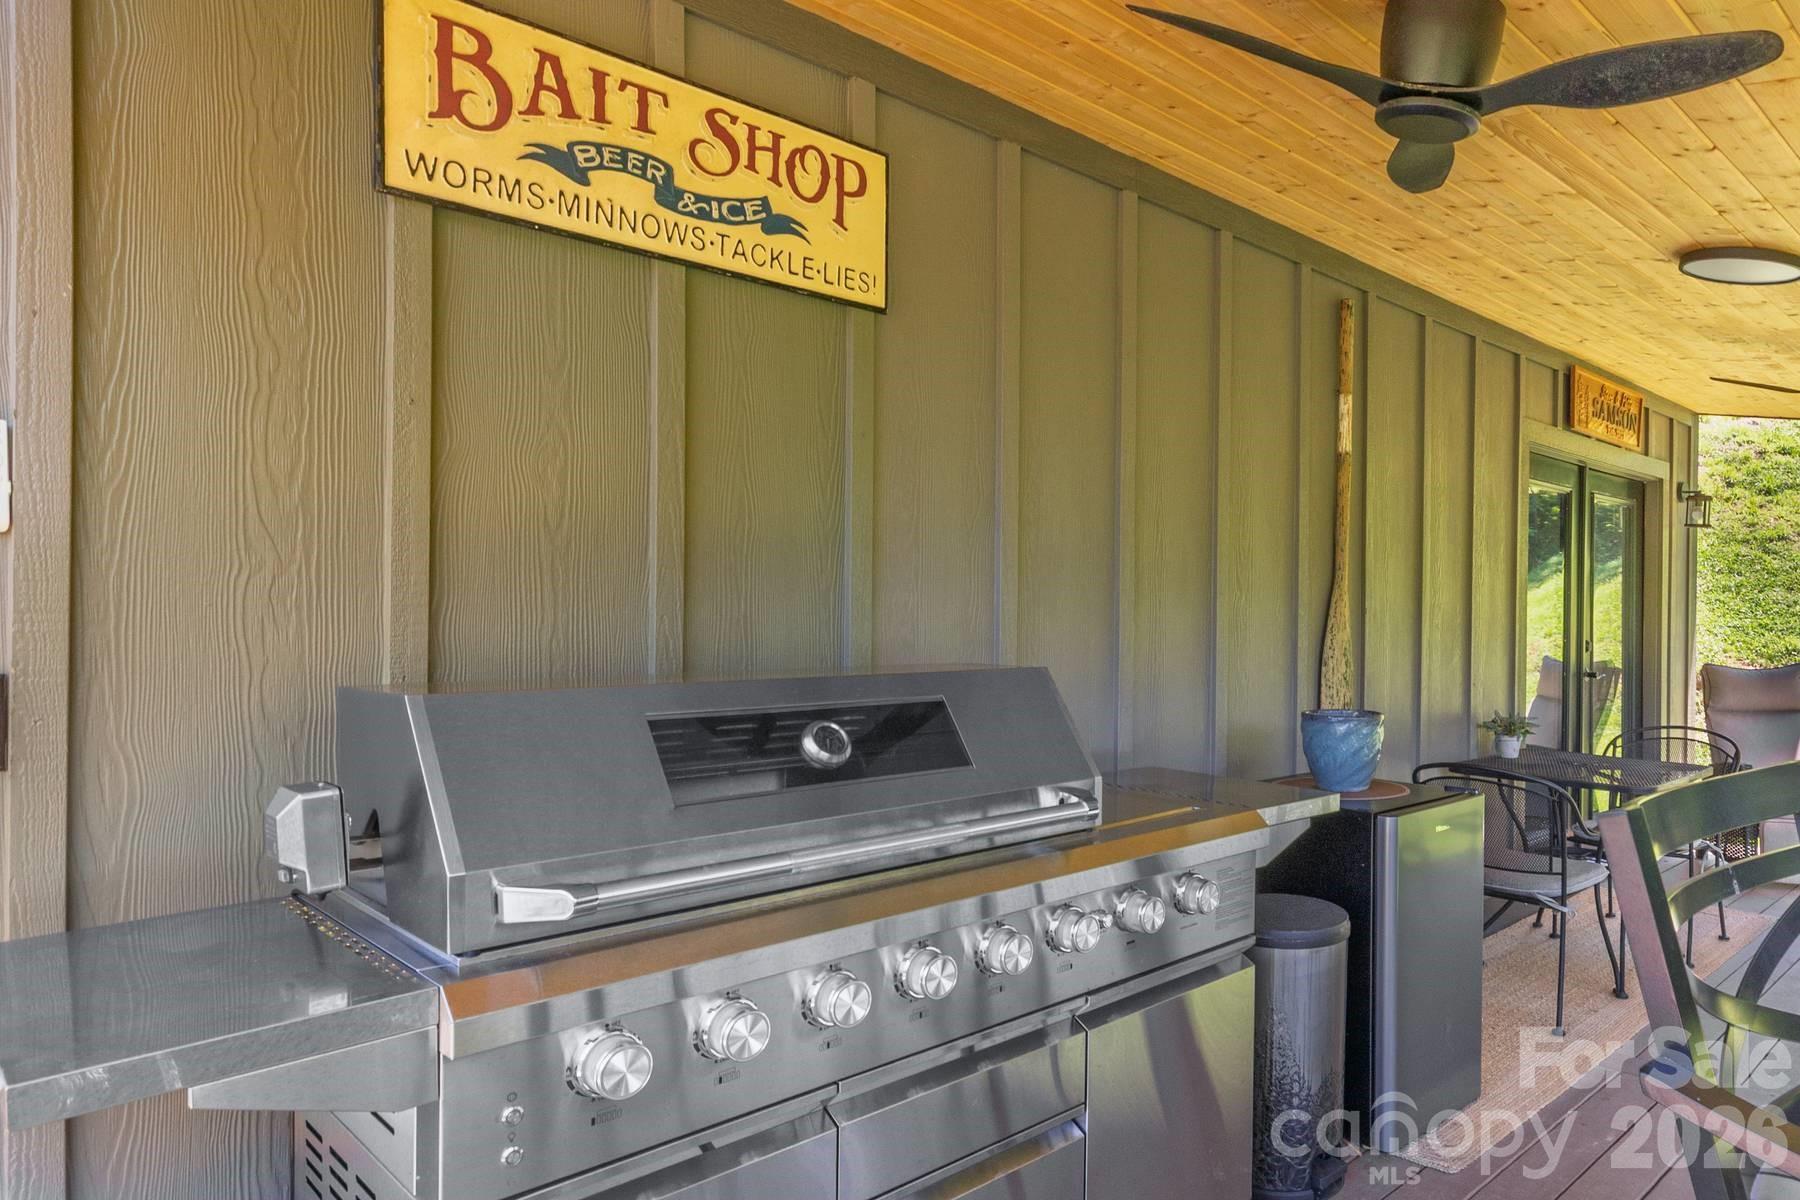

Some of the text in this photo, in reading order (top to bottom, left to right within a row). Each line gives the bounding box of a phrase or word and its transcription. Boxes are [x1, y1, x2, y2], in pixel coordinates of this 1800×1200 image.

[427, 14, 868, 232] BAIT SHOP
[573, 143, 669, 185] BEER
[1591, 396, 1638, 434] SAMSON
